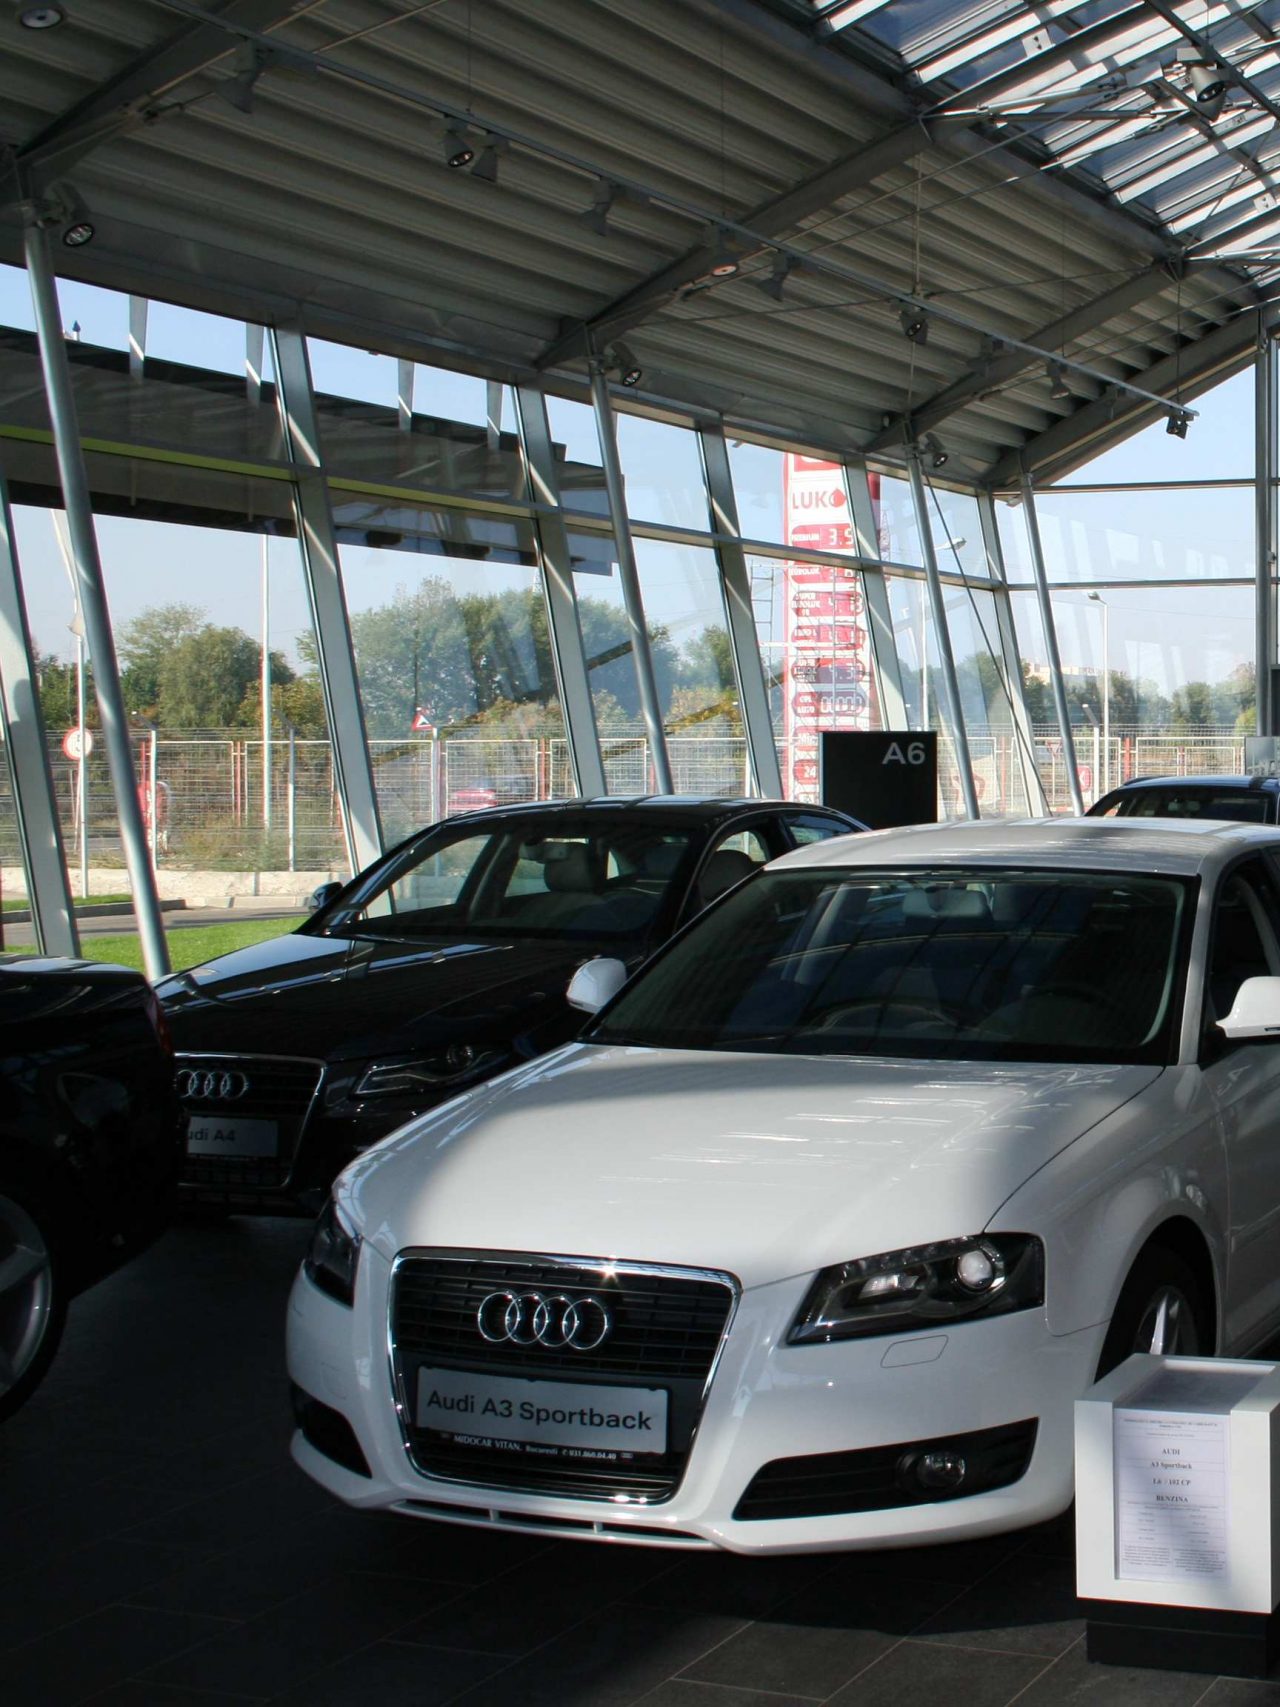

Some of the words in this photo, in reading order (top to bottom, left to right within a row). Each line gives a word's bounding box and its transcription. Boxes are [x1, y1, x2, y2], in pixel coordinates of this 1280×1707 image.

[792, 488, 847, 509] LUKO
[882, 742, 926, 765] A6
[214, 1129, 236, 1142] A4
[427, 1390, 475, 1414] Audi
[481, 1398, 513, 1418] A3
[519, 1402, 652, 1431] Sportback
[454, 1434, 493, 1448] MIDOCAR
[1162, 1448, 1181, 1456] AUDI
